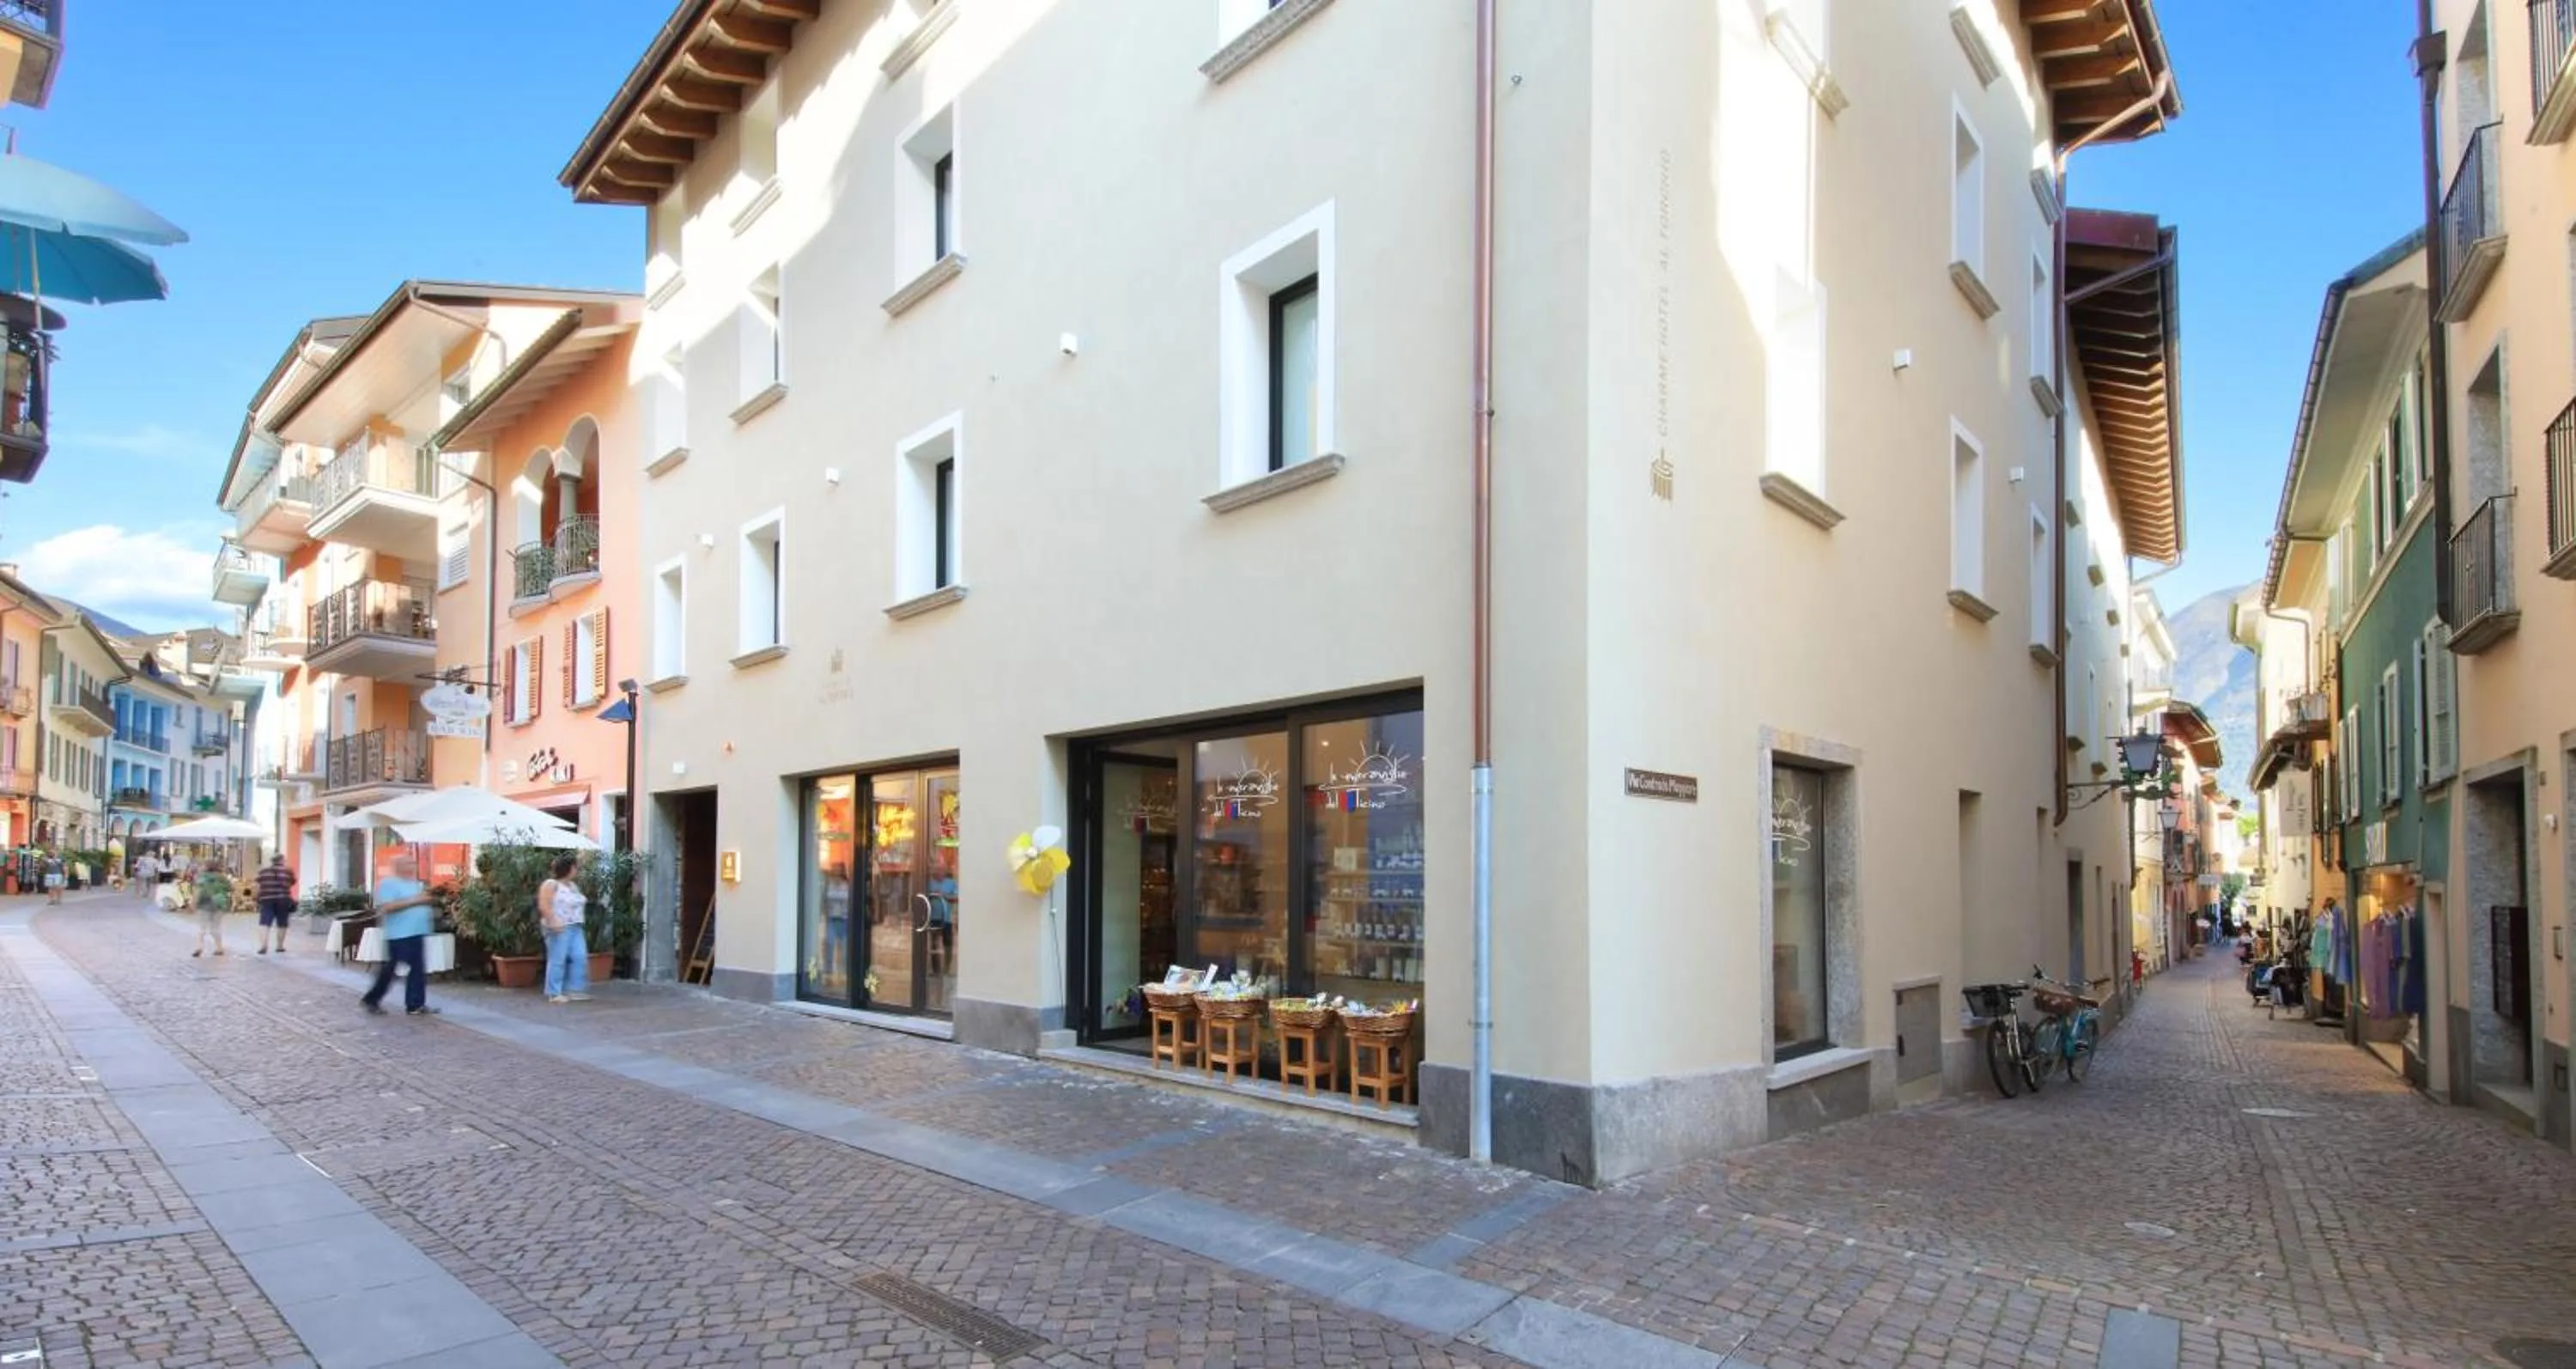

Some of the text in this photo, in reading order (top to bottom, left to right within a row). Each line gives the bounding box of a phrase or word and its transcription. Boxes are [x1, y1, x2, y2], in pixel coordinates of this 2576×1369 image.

[1658, 286, 1670, 346] HOTEL
[1231, 798, 1262, 818] Ticino
[1346, 788, 1386, 809] Ticino
